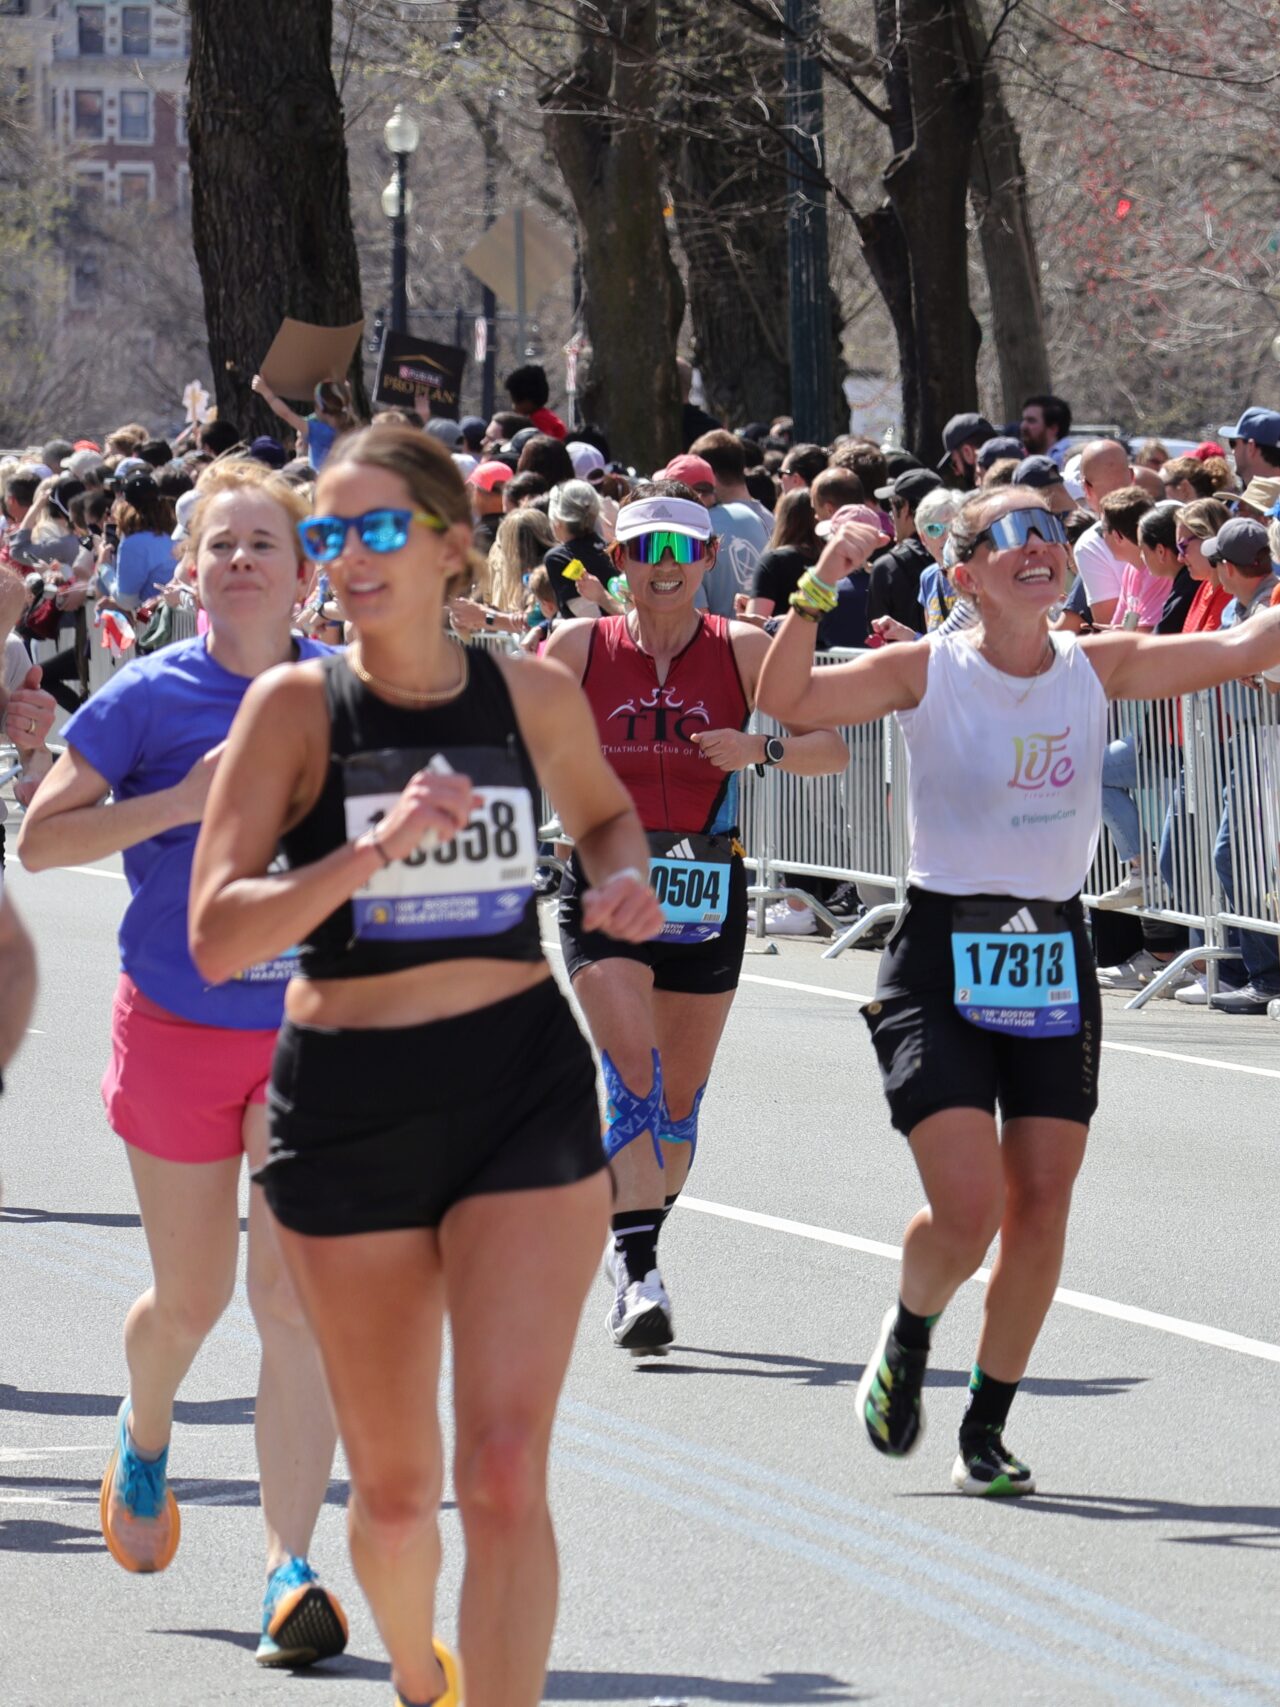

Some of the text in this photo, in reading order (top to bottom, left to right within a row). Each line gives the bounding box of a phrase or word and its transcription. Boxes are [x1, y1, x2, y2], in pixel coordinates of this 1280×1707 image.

[966, 942, 1064, 987] 17313
[960, 990, 969, 1001] 2
[1000, 1009, 1035, 1018] BOSTON
[984, 1016, 1036, 1027] MARATHON
